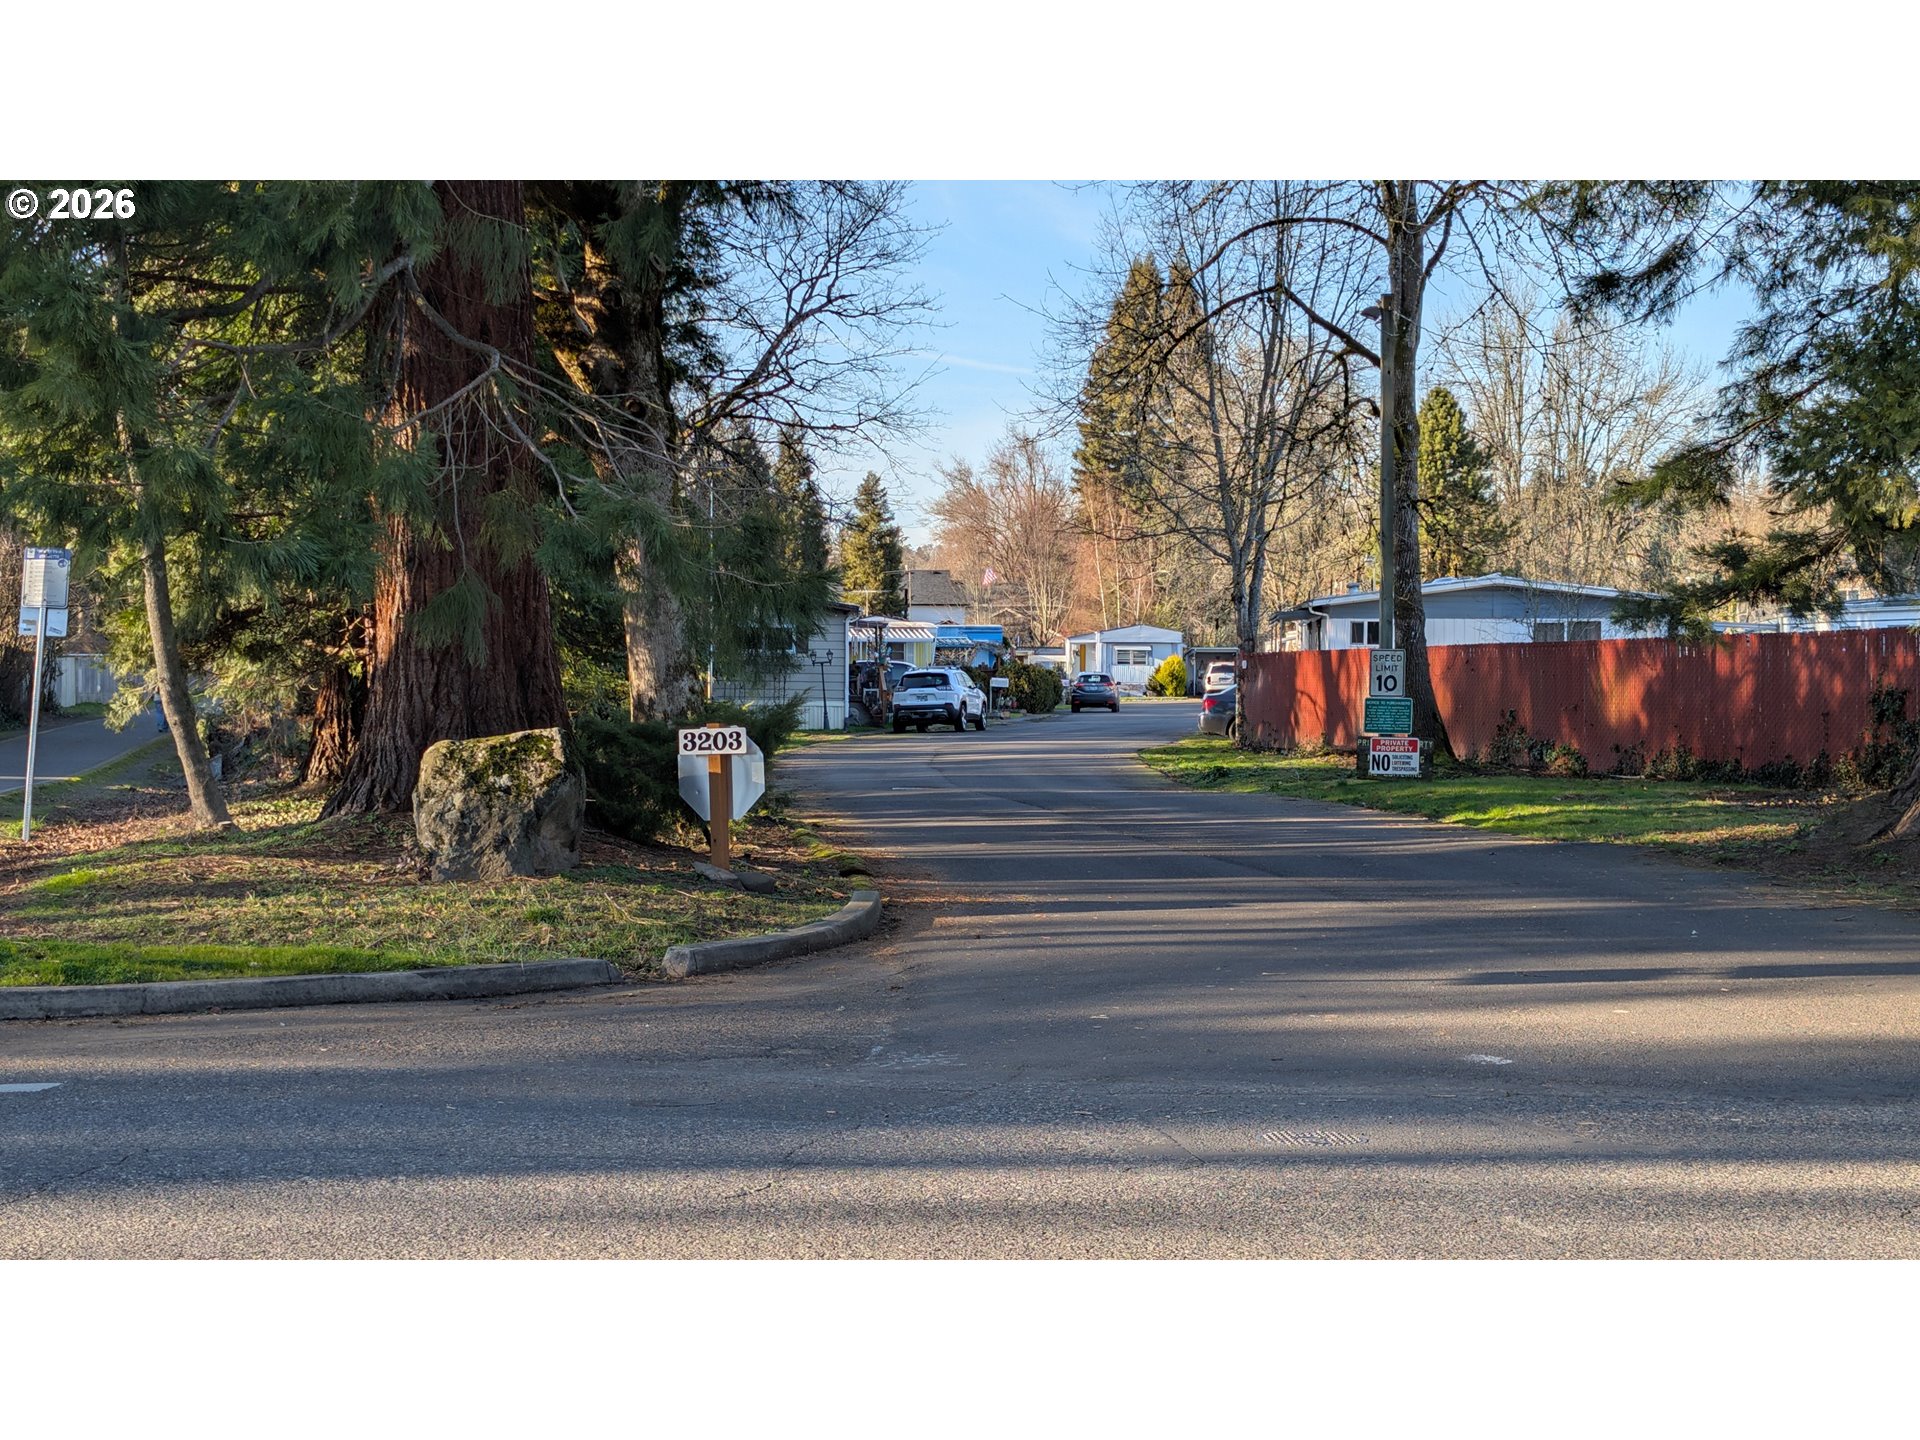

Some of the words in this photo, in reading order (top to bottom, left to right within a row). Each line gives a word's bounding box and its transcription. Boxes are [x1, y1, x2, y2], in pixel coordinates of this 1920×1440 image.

[1373, 654, 1403, 662] SPEED
[1375, 664, 1399, 672] LIMIT
[1376, 674, 1398, 692] 10
[682, 731, 743, 752] 3203
[1372, 754, 1391, 772] NO
